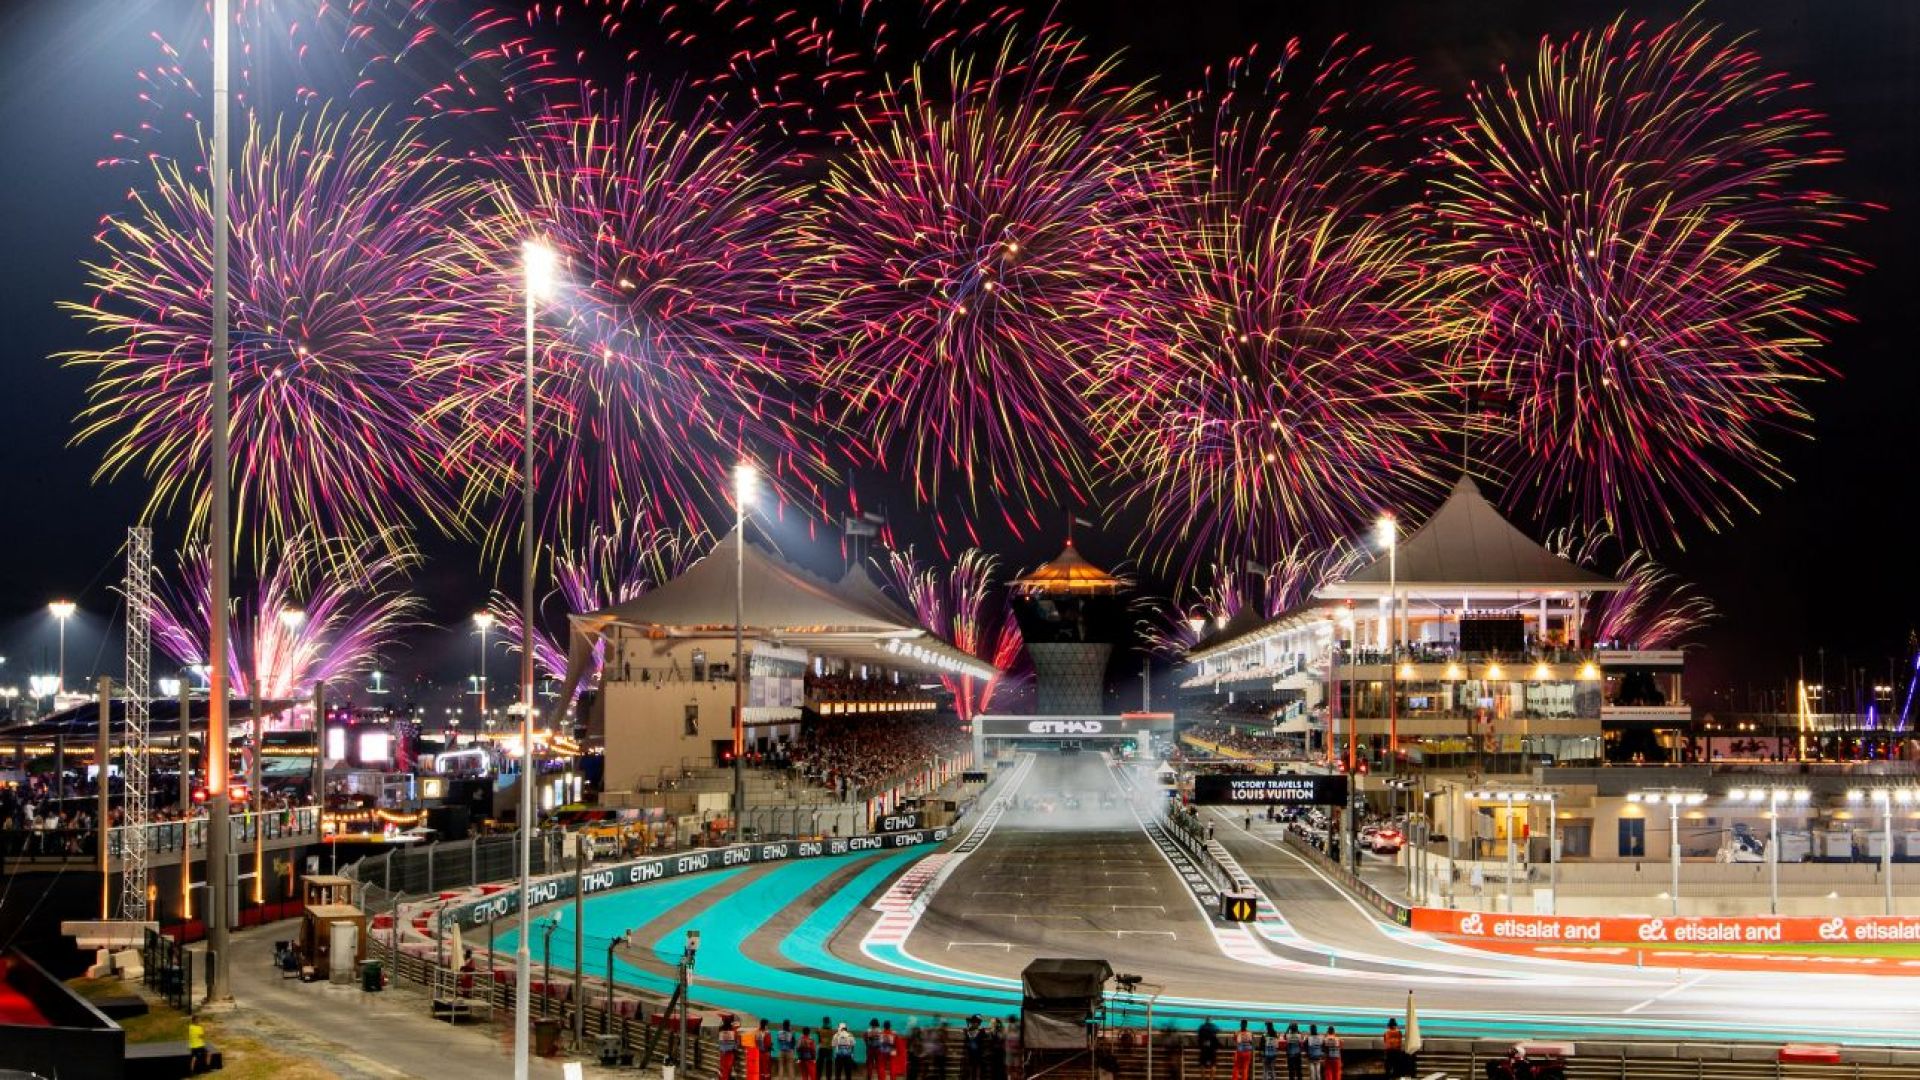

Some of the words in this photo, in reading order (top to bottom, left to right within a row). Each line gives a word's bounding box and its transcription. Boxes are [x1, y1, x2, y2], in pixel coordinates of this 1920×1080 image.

[1028, 720, 1102, 733] ETIHAD
[1232, 790, 1264, 800] LOUIS
[1267, 790, 1314, 799] VUITTON
[884, 815, 916, 830] ETIHAD
[849, 836, 882, 850] ETIHAD
[895, 832, 923, 846] ETIHAD
[724, 848, 751, 865] ETIHAD
[763, 844, 787, 859] ETIHAD
[799, 842, 822, 856] ETIHAD
[678, 854, 708, 873] ETIHAD
[630, 862, 663, 882] ETIHAD
[581, 870, 614, 892] TIHAD
[1460, 914, 1484, 935] e&
[1493, 920, 1560, 938] etisalat
[1564, 922, 1600, 939] and
[1639, 918, 1668, 941] e&
[1674, 922, 1741, 941] etisalat
[1745, 922, 1781, 941] and
[1819, 917, 1848, 941] e&
